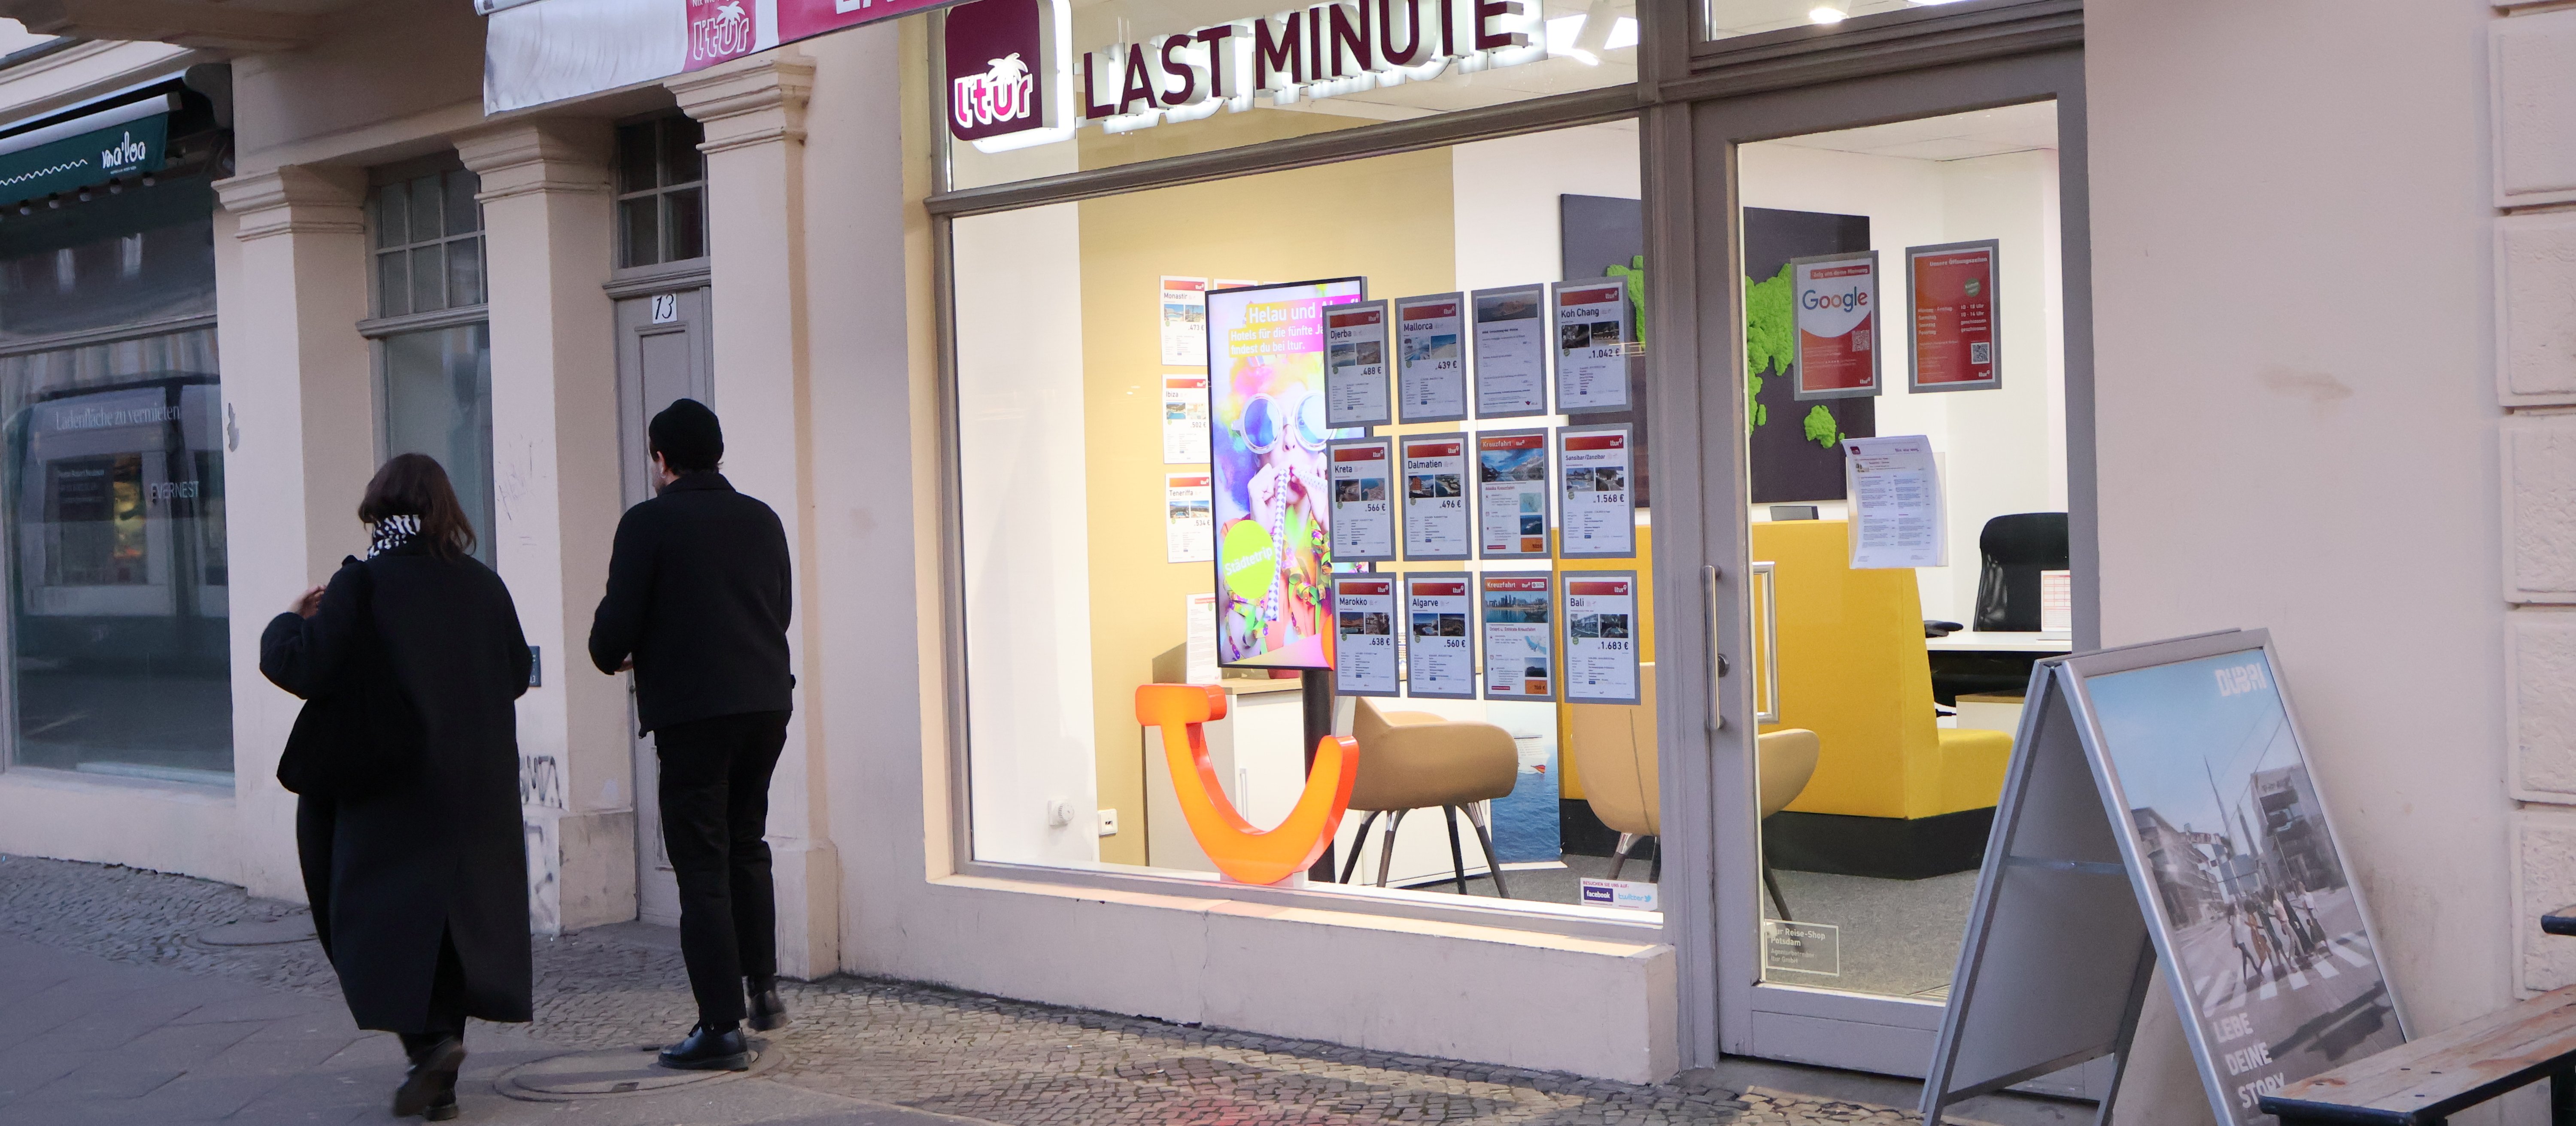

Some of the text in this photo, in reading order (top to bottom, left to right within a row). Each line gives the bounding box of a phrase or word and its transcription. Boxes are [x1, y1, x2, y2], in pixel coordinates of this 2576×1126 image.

[1084, 0, 1512, 119] LAST MINUTE
[655, 294, 674, 320] 13
[1803, 286, 1868, 313] Google
[1249, 307, 1287, 324] Helau
[1291, 302, 1316, 320] und
[1561, 309, 1599, 318] Koh Chang
[1231, 329, 1256, 341] Hotels
[1259, 328, 1270, 339] für
[1273, 327, 1285, 338] die
[1288, 324, 1312, 337] fünfte
[1331, 329, 1352, 339] Djerba
[1404, 323, 1433, 331] Mallorca
[1231, 344, 1257, 355] findest
[1260, 342, 1270, 352] du
[1273, 342, 1285, 351] bei
[1592, 349, 1613, 358] 1.042
[55, 401, 180, 430] Ladenfläche zu vermieten
[1408, 460, 1442, 469] Dalmatien
[151, 481, 199, 499] EVERNEST
[1225, 546, 1272, 576] Städtetrip
[1413, 599, 1438, 608] Algarve
[1586, 890, 1610, 898] facebook
[1771, 937, 1801, 946] Potsdam
[1785, 928, 1825, 941] Reise-Shop
[2213, 1013, 2254, 1043] LEBE
[2225, 1042, 2272, 1075] DEINE
[2238, 1072, 2285, 1108] STORY
